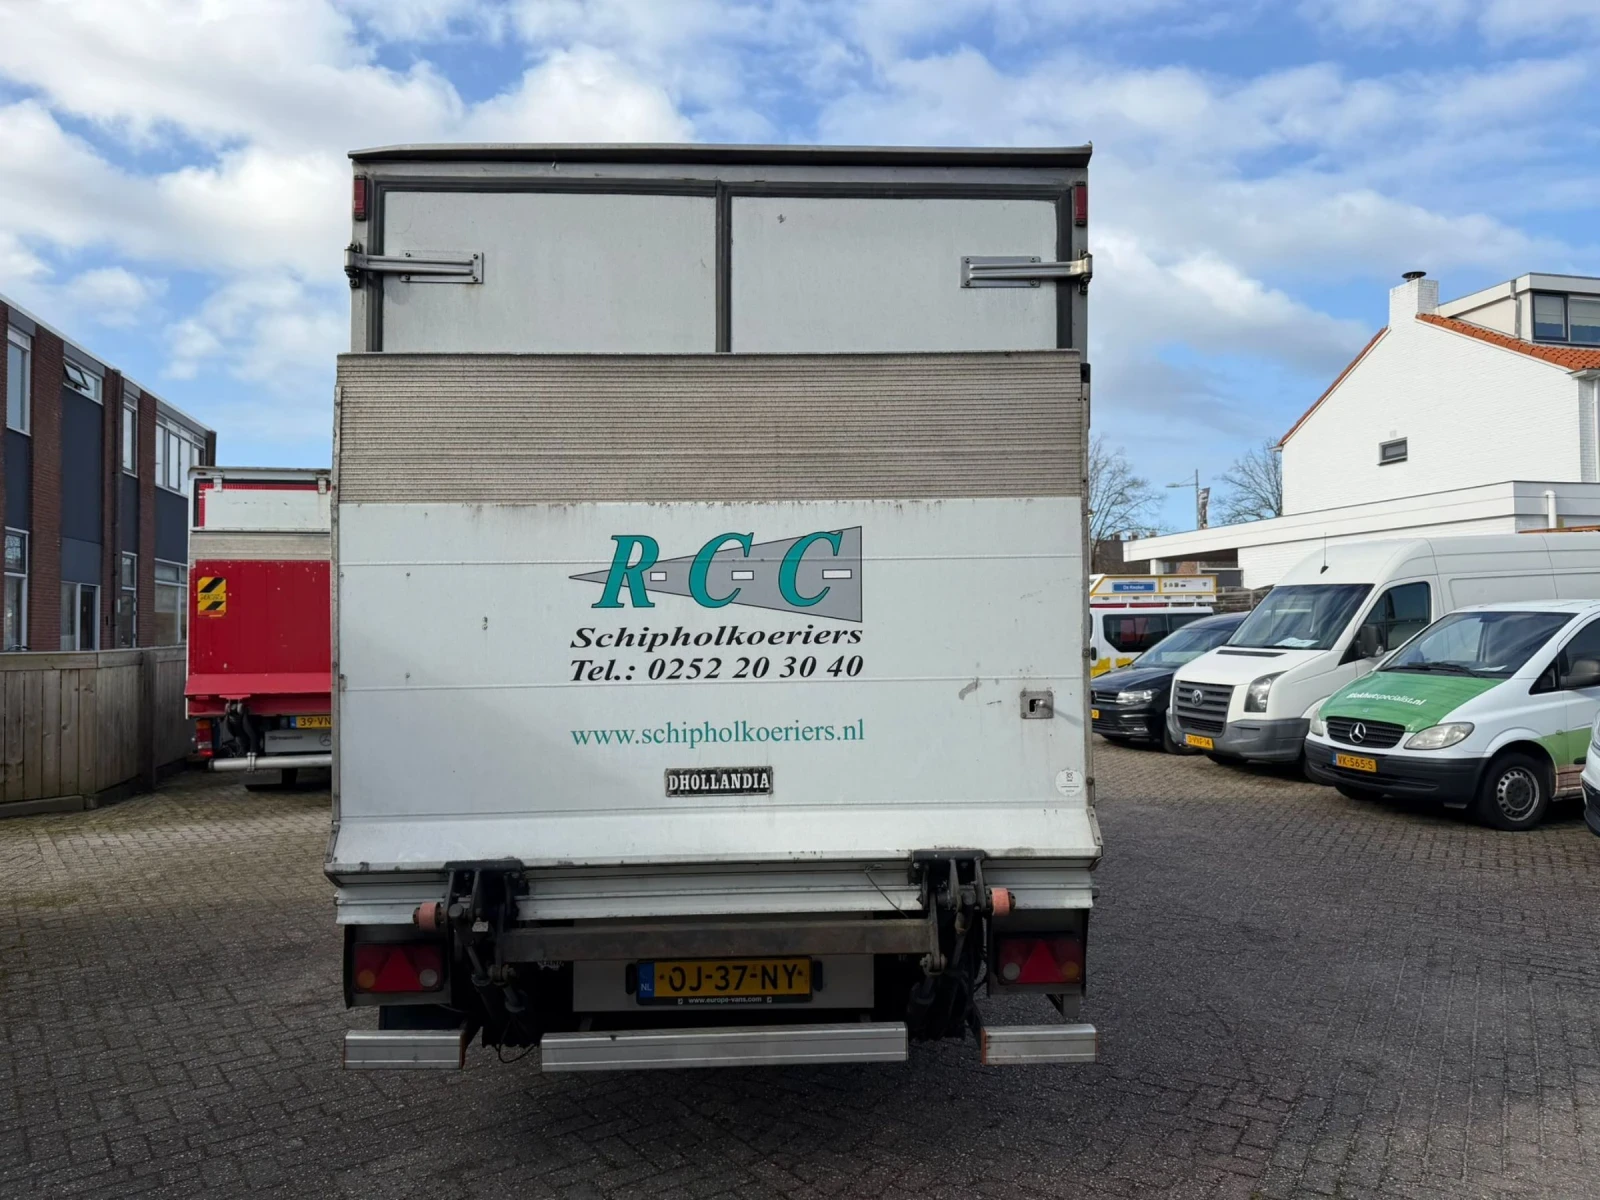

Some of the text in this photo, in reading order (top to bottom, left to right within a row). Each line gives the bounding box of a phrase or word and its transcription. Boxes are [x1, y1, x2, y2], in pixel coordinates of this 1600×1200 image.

[570, 624, 863, 653] Schipholkoeriers
[570, 655, 864, 682] Tel.: 0252 20 30 40
[570, 718, 865, 749] www.schipholkoeriers.nl
[668, 773, 770, 790] DHOLLANDIA
[668, 963, 798, 992] OJ-37-NY
